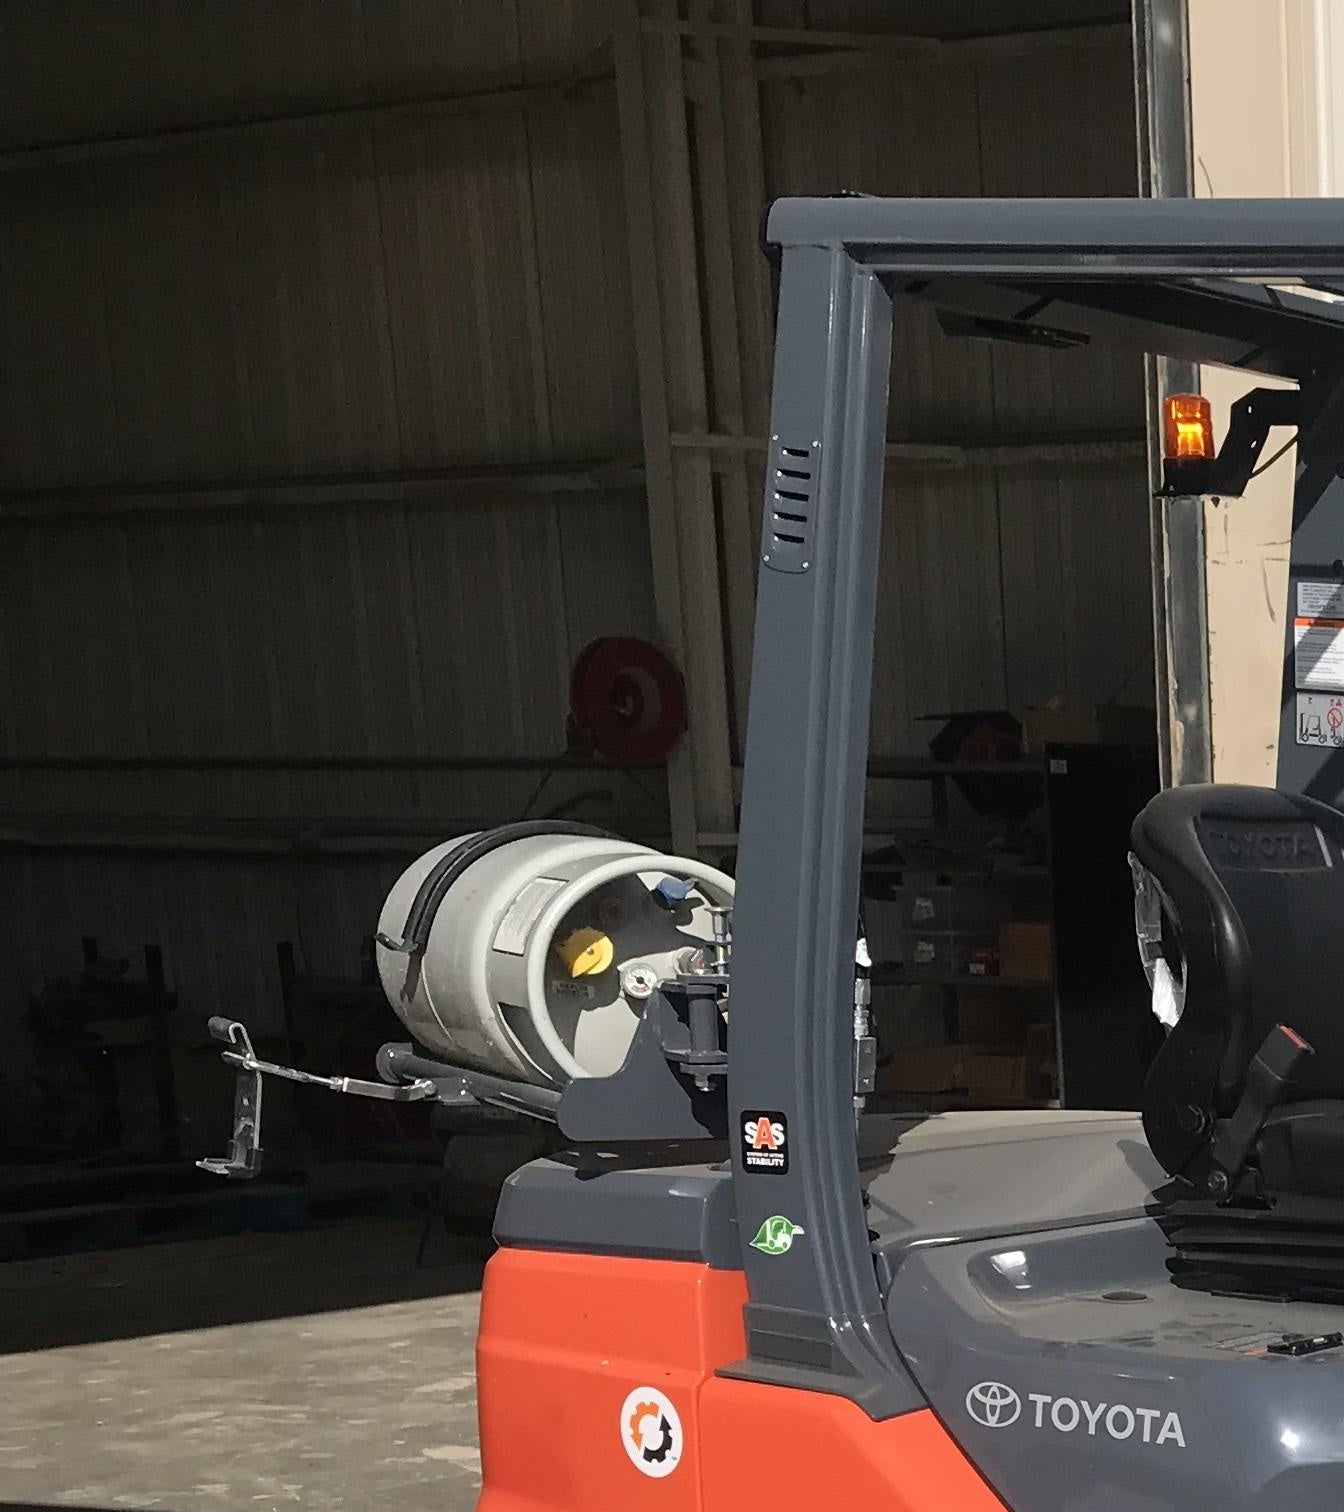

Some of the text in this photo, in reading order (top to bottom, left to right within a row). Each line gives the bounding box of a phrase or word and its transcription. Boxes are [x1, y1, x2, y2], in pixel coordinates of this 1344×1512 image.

[744, 1116, 785, 1150] SAS
[746, 1158, 784, 1167] STABILITY
[1029, 1393, 1186, 1448] TOYOTA
